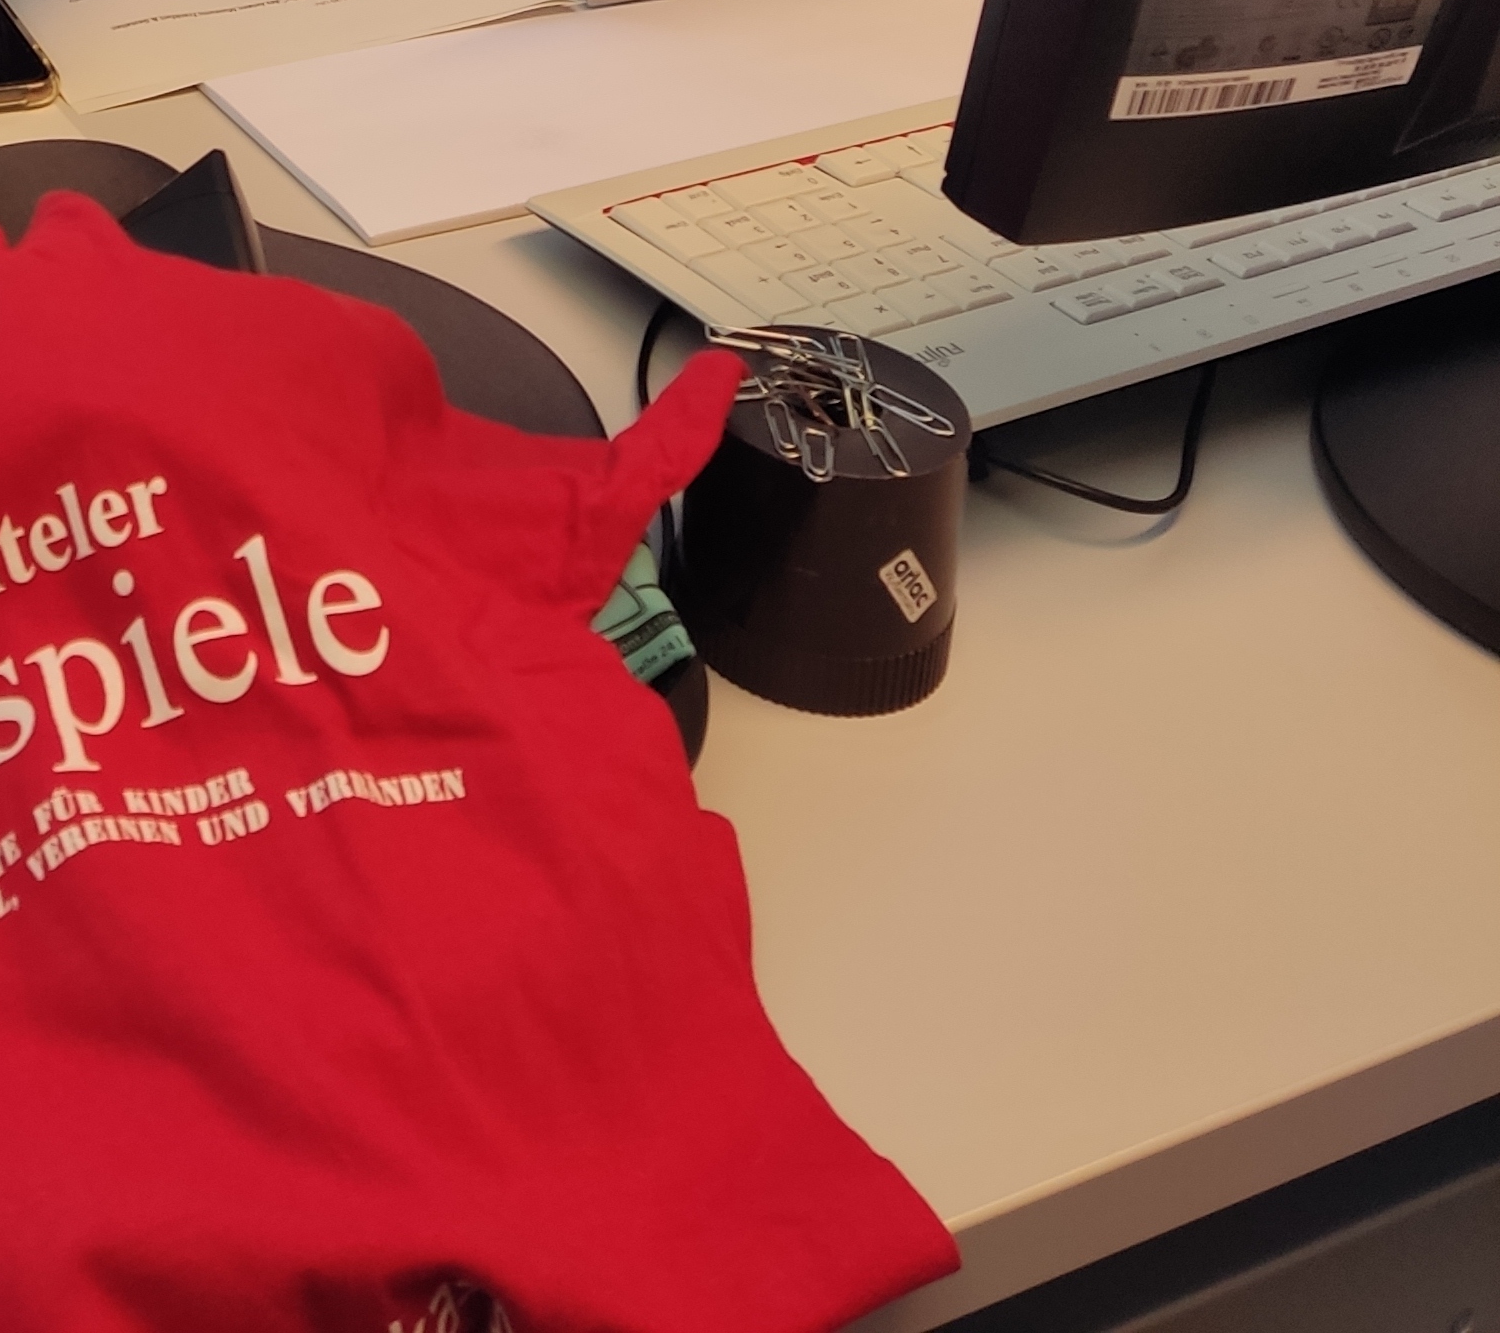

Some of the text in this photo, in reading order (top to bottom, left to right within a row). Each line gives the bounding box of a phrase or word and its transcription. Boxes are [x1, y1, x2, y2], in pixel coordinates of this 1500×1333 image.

[31, 785, 104, 835] FÜR
[121, 766, 256, 817] KINDER
[25, 815, 182, 882] VEREINEN
[196, 799, 270, 847] UND
